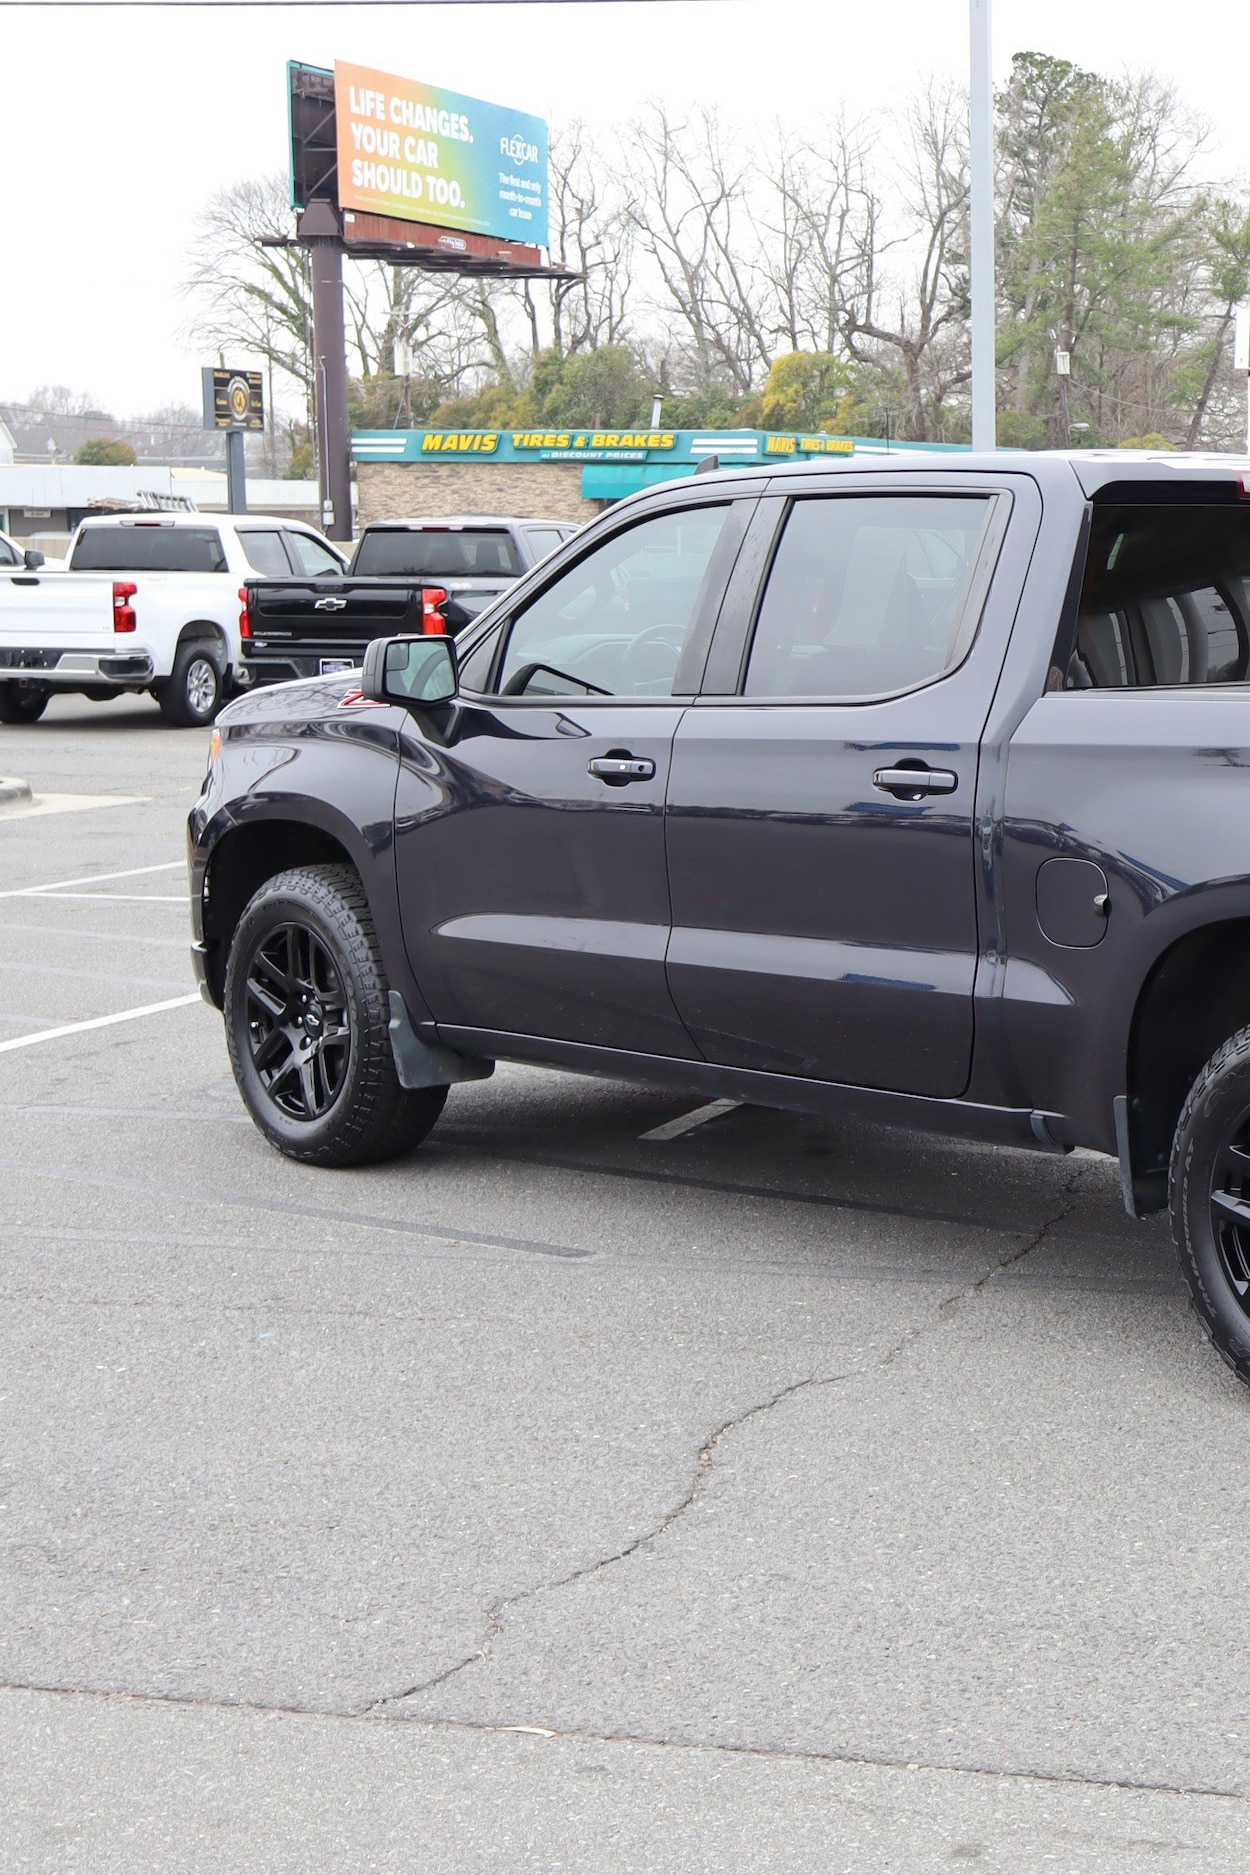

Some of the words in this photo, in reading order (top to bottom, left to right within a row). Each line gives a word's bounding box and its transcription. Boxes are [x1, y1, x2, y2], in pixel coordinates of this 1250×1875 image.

[349, 86, 386, 120] LIFE
[389, 97, 474, 143] CHANGES.
[350, 122, 401, 159] YOUR
[404, 136, 439, 168] CAR
[500, 136, 539, 163] FLEXCAR
[352, 158, 423, 199] SHOULD
[426, 175, 465, 208] TOO.
[423, 433, 499, 451] MAVIS
[512, 434, 571, 448] TIRES
[574, 435, 588, 447] &
[591, 434, 675, 448] BRAKES
[767, 436, 796, 453] MAVIS
